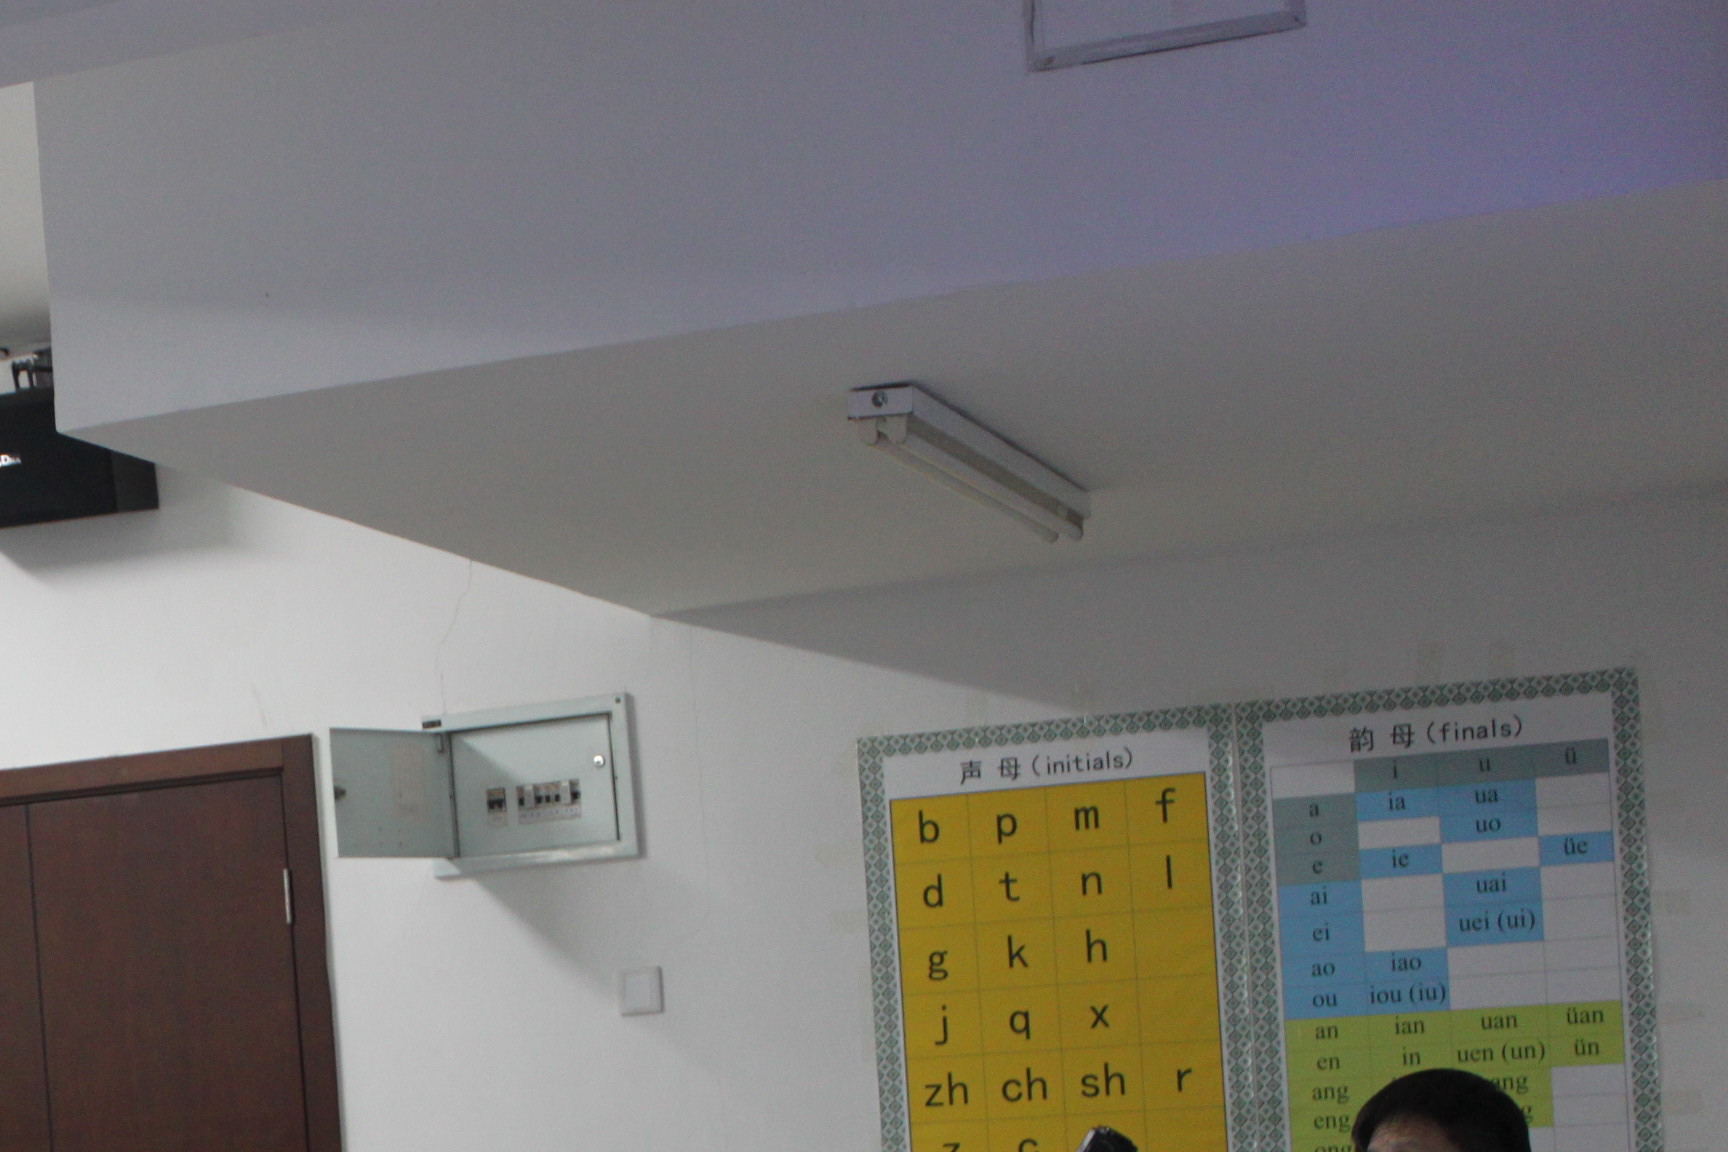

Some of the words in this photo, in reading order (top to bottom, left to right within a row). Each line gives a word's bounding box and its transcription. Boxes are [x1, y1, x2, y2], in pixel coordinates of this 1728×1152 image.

[1426, 713, 1524, 745] (finals)
[1031, 747, 1134, 777] (initials)
[1392, 758, 1399, 780] i
[1477, 757, 1491, 773] u
[917, 809, 940, 844] b
[996, 812, 1017, 844] p
[1073, 804, 1100, 831] m
[1155, 786, 1176, 823] f
[1308, 803, 1320, 818] a
[1388, 791, 1406, 811] ia
[1474, 788, 1499, 805] ua
[1310, 833, 1323, 847] o
[1475, 817, 1502, 834] uo
[1312, 861, 1323, 875] e
[1391, 848, 1409, 869] ie
[1563, 836, 1588, 857] üe
[922, 873, 944, 908] d
[999, 871, 1020, 902] t
[1080, 870, 1103, 896] n
[1165, 854, 1173, 889] l
[1310, 886, 1328, 906] ai
[1475, 870, 1508, 893] uai
[1312, 922, 1331, 943] ei
[1458, 910, 1490, 932] uei
[1496, 906, 1537, 933] (ui)
[928, 949, 949, 981] g
[1007, 934, 1030, 969] k
[1085, 929, 1108, 963] h
[1311, 962, 1336, 978] ao
[1390, 951, 1423, 971] iao
[1312, 992, 1338, 1008] ou
[1370, 983, 1403, 1005] iou
[1408, 982, 1447, 1008] (iu)
[934, 1004, 949, 1046] j
[1009, 1009, 1031, 1040] q
[1090, 1004, 1111, 1029] x
[1315, 1024, 1340, 1040] an
[1394, 1015, 1426, 1036] ian
[1480, 1013, 1519, 1030] uan
[1566, 1004, 1606, 1026] üan
[1317, 1054, 1342, 1071] en
[1402, 1045, 1422, 1066] in
[1457, 1046, 1495, 1063] uen
[1501, 1041, 1547, 1065] (un)
[1574, 1036, 1601, 1057] ün
[925, 1071, 970, 1108] zh
[1001, 1067, 1049, 1102] ch
[1081, 1062, 1127, 1098] sh
[1176, 1067, 1193, 1093] r
[1312, 1083, 1350, 1103] ang
[1314, 1112, 1351, 1133] eng
